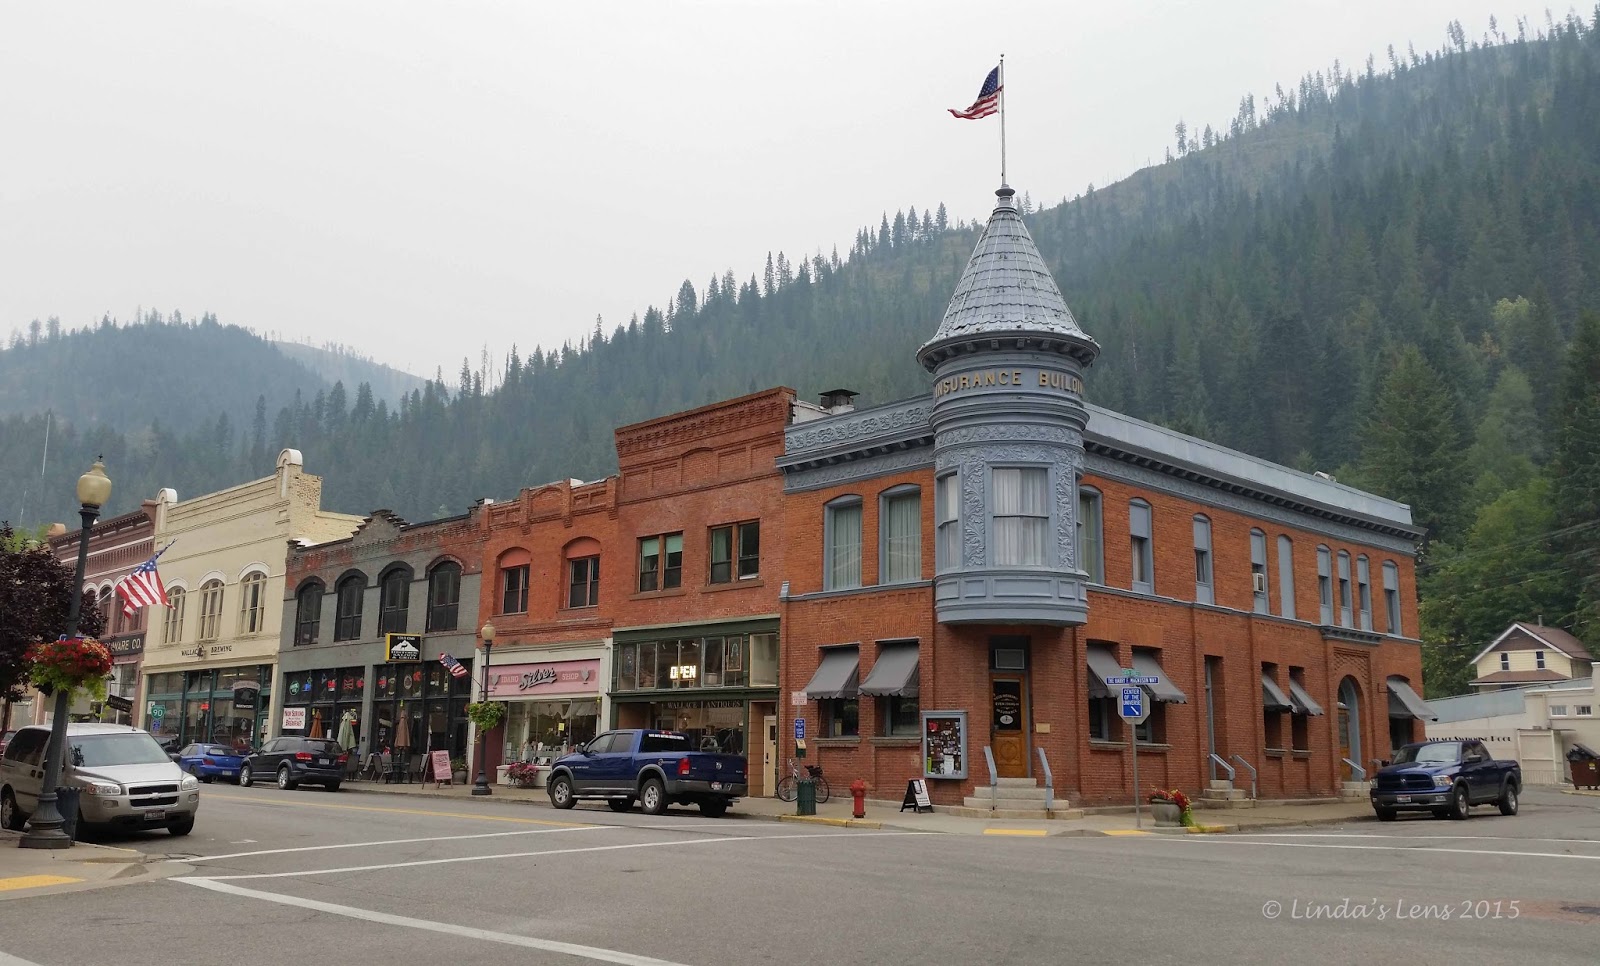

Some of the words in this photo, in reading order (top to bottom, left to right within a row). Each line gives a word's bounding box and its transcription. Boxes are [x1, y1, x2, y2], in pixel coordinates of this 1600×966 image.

[935, 371, 1022, 398] INSURANCE
[669, 665, 697, 679] OPEN
[501, 675, 519, 684] IDAHO
[519, 667, 557, 692] Silver
[561, 672, 579, 681] SHOP
[706, 700, 741, 709] ANTIQUES
[153, 709, 163, 717] 90
